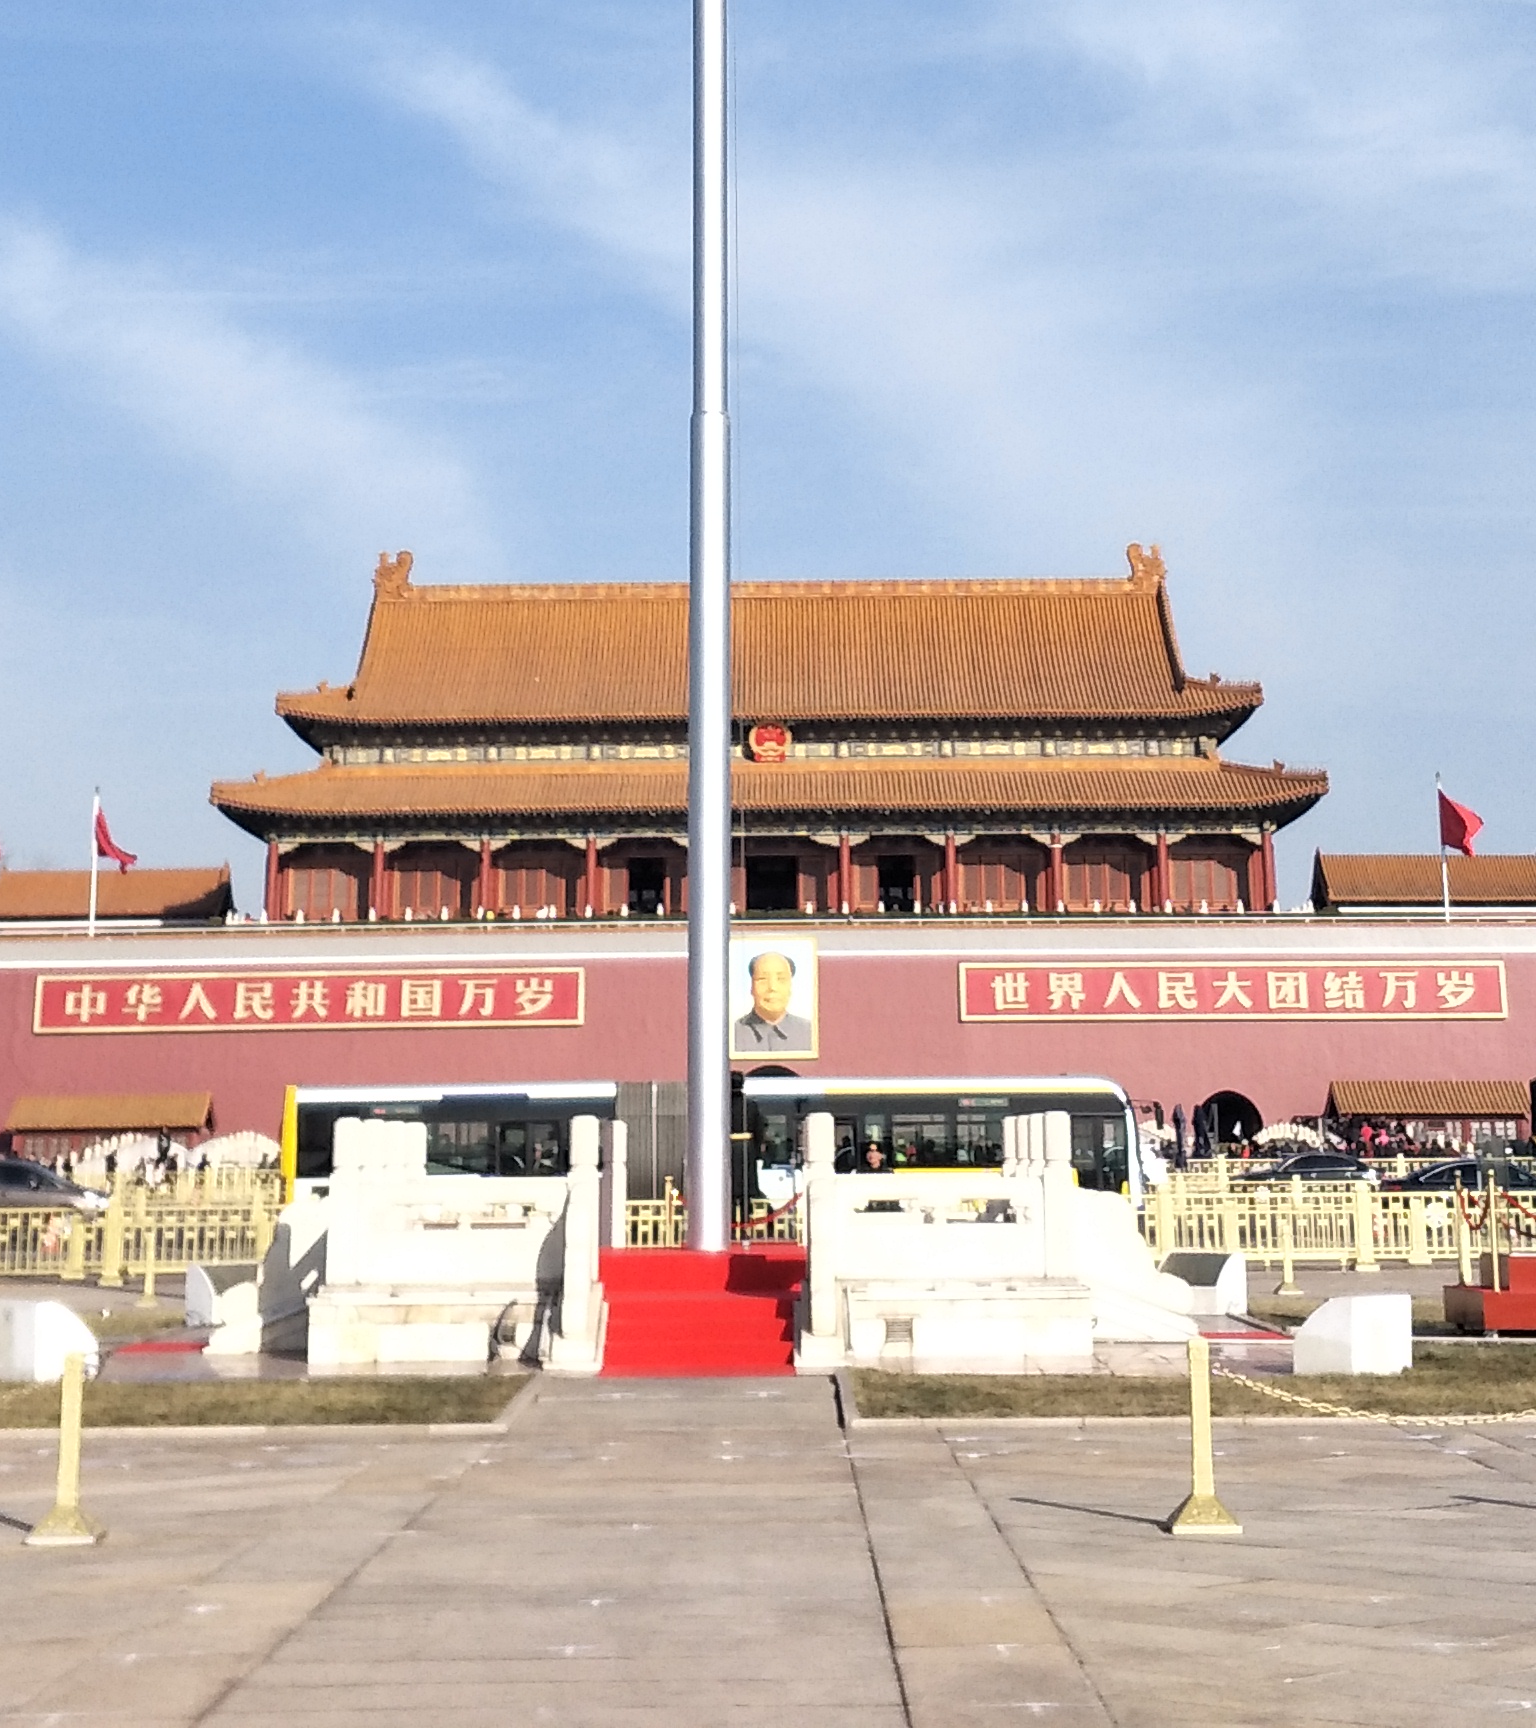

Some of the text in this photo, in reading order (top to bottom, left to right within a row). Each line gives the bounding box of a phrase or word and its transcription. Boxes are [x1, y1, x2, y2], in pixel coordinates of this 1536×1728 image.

[64, 977, 556, 1023] 中华人民共和国万岁
[991, 971, 1476, 1011] 世界人民大团结万岁
